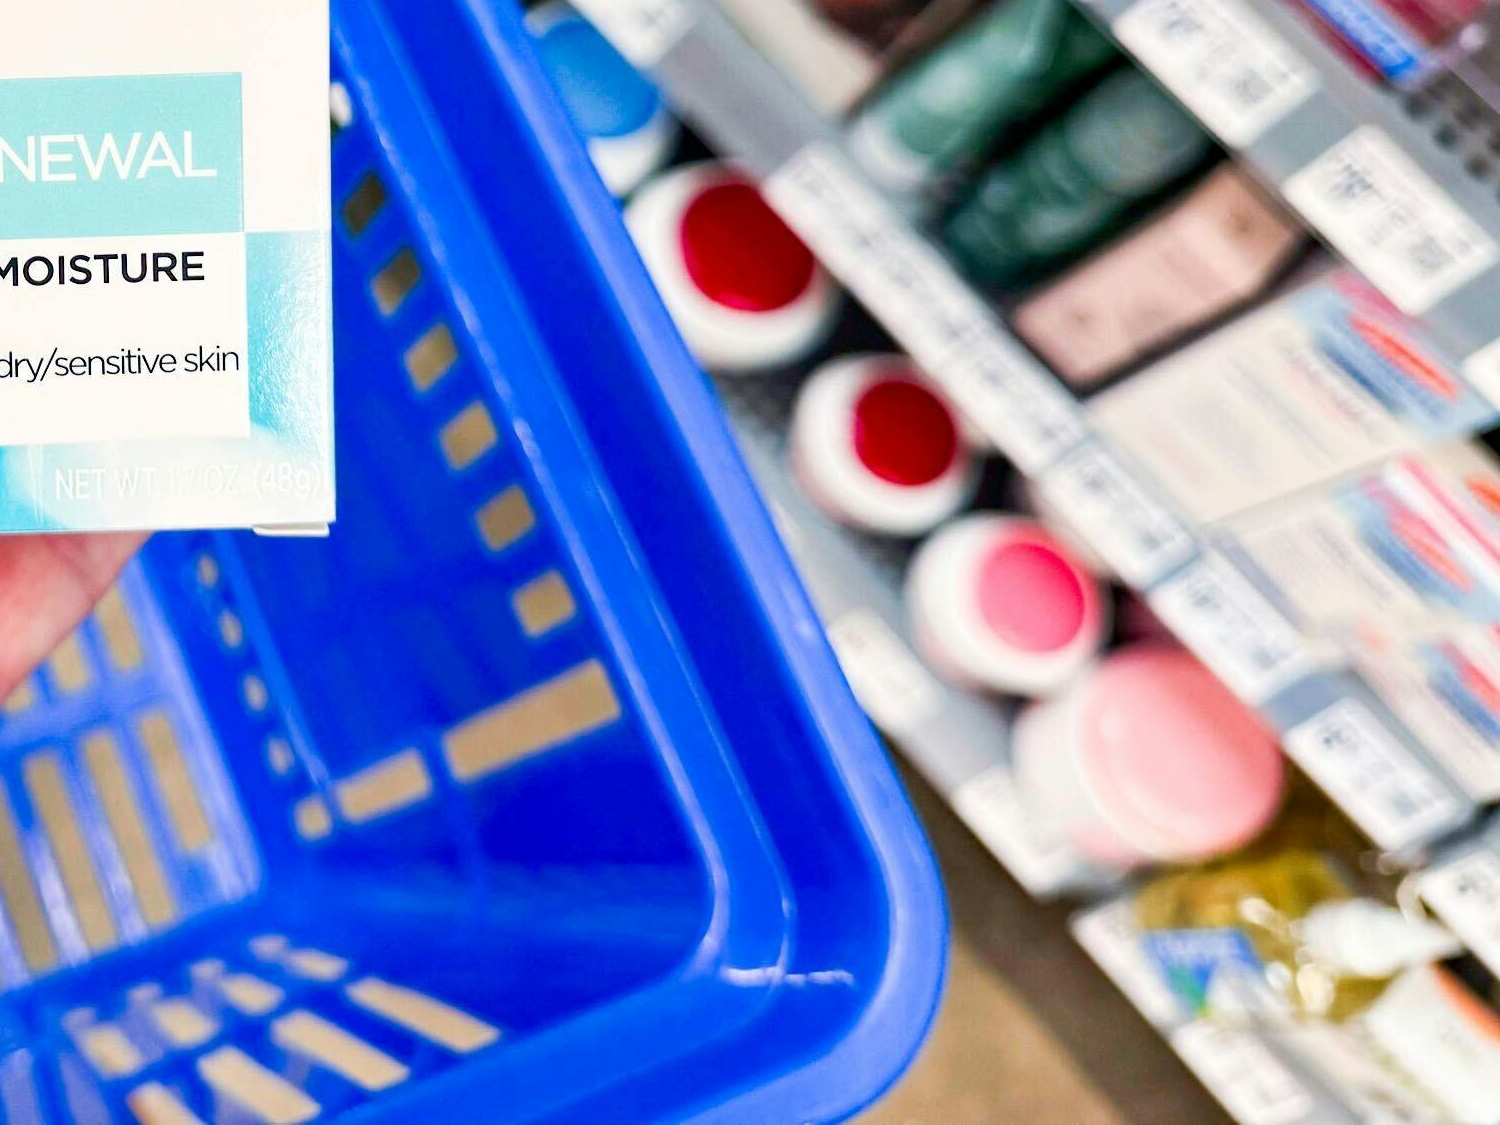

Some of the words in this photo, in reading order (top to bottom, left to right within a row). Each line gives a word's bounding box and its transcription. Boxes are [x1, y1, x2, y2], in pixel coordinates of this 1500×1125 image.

[184, 345, 240, 373] skin
[55, 467, 106, 500] NET
[252, 459, 323, 499] (48g)
